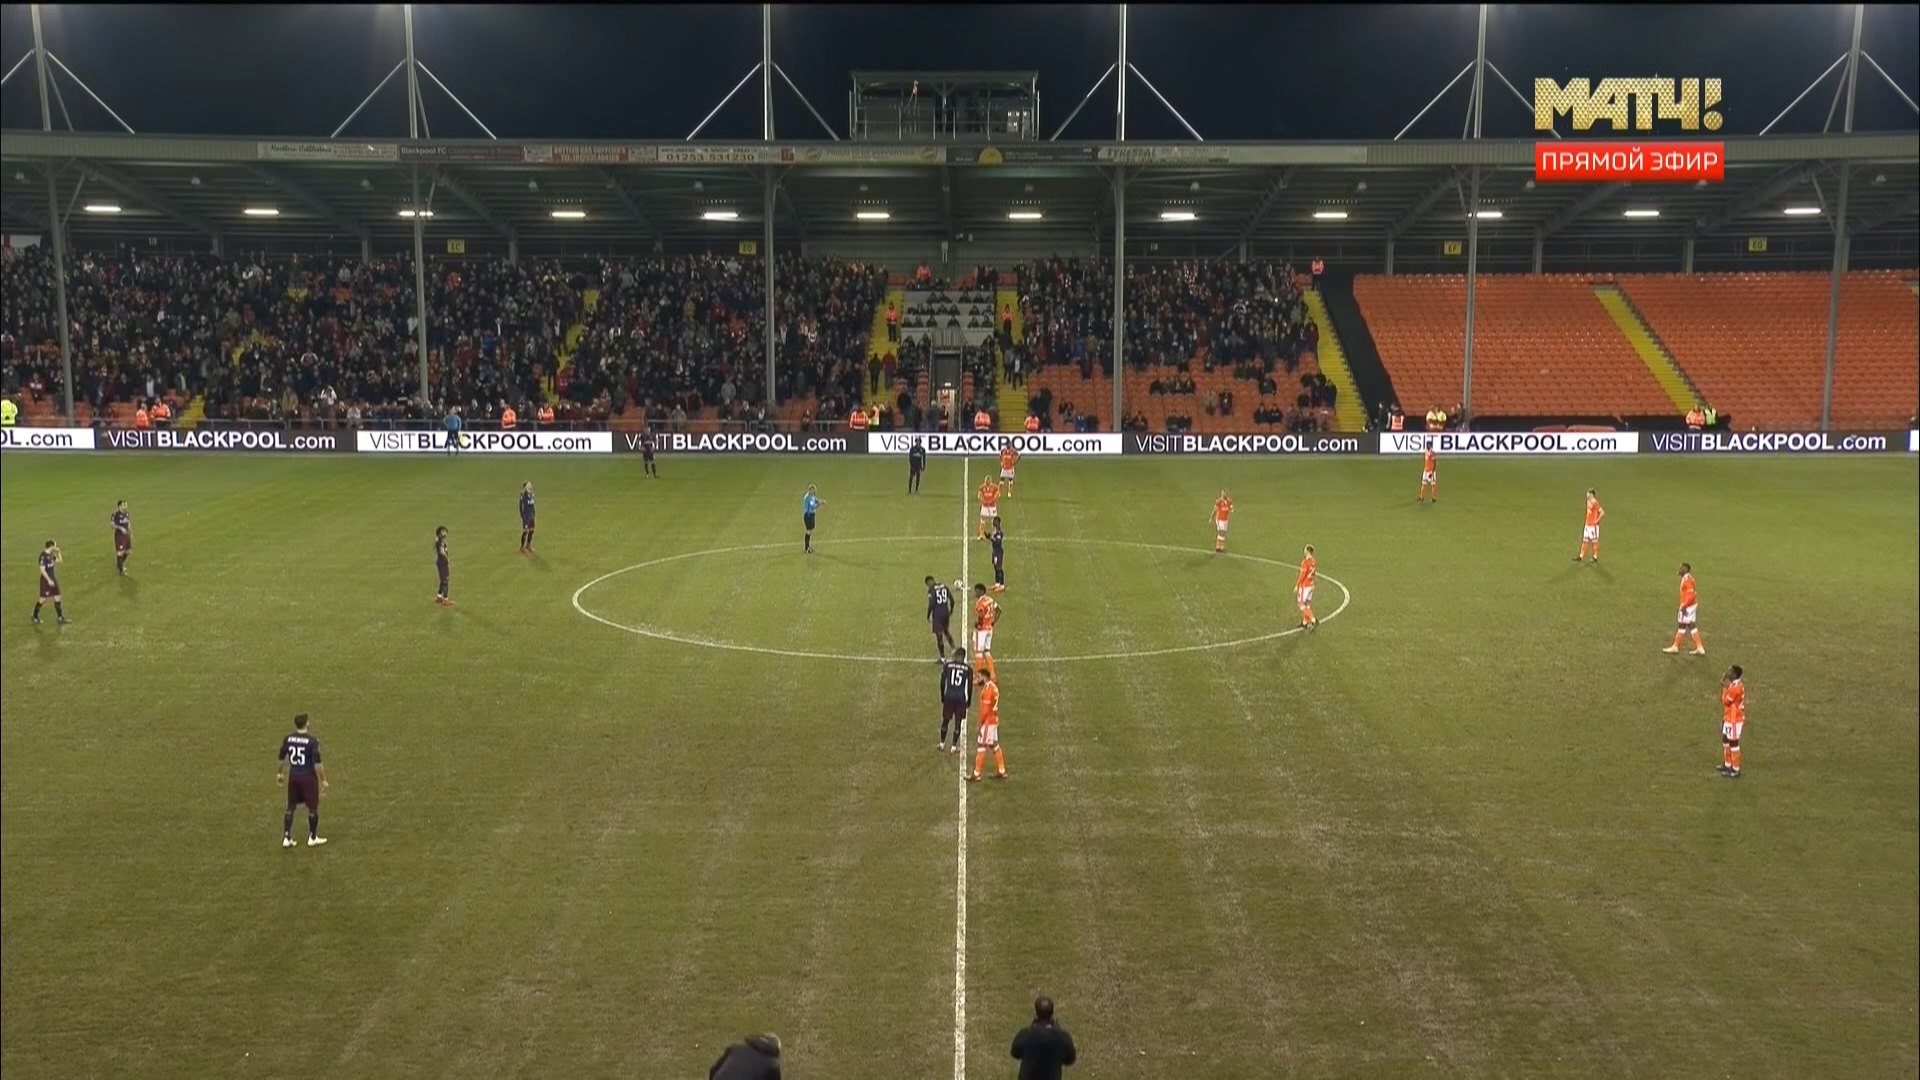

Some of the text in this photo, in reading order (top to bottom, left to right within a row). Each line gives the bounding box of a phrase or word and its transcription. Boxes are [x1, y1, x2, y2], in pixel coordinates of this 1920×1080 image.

[401, 147, 437, 155] Blackpool
[666, 153, 705, 161] 01253
[708, 153, 755, 161] 531230
[935, 588, 948, 605] 59
[950, 669, 964, 687] 15
[288, 745, 306, 766] 25
